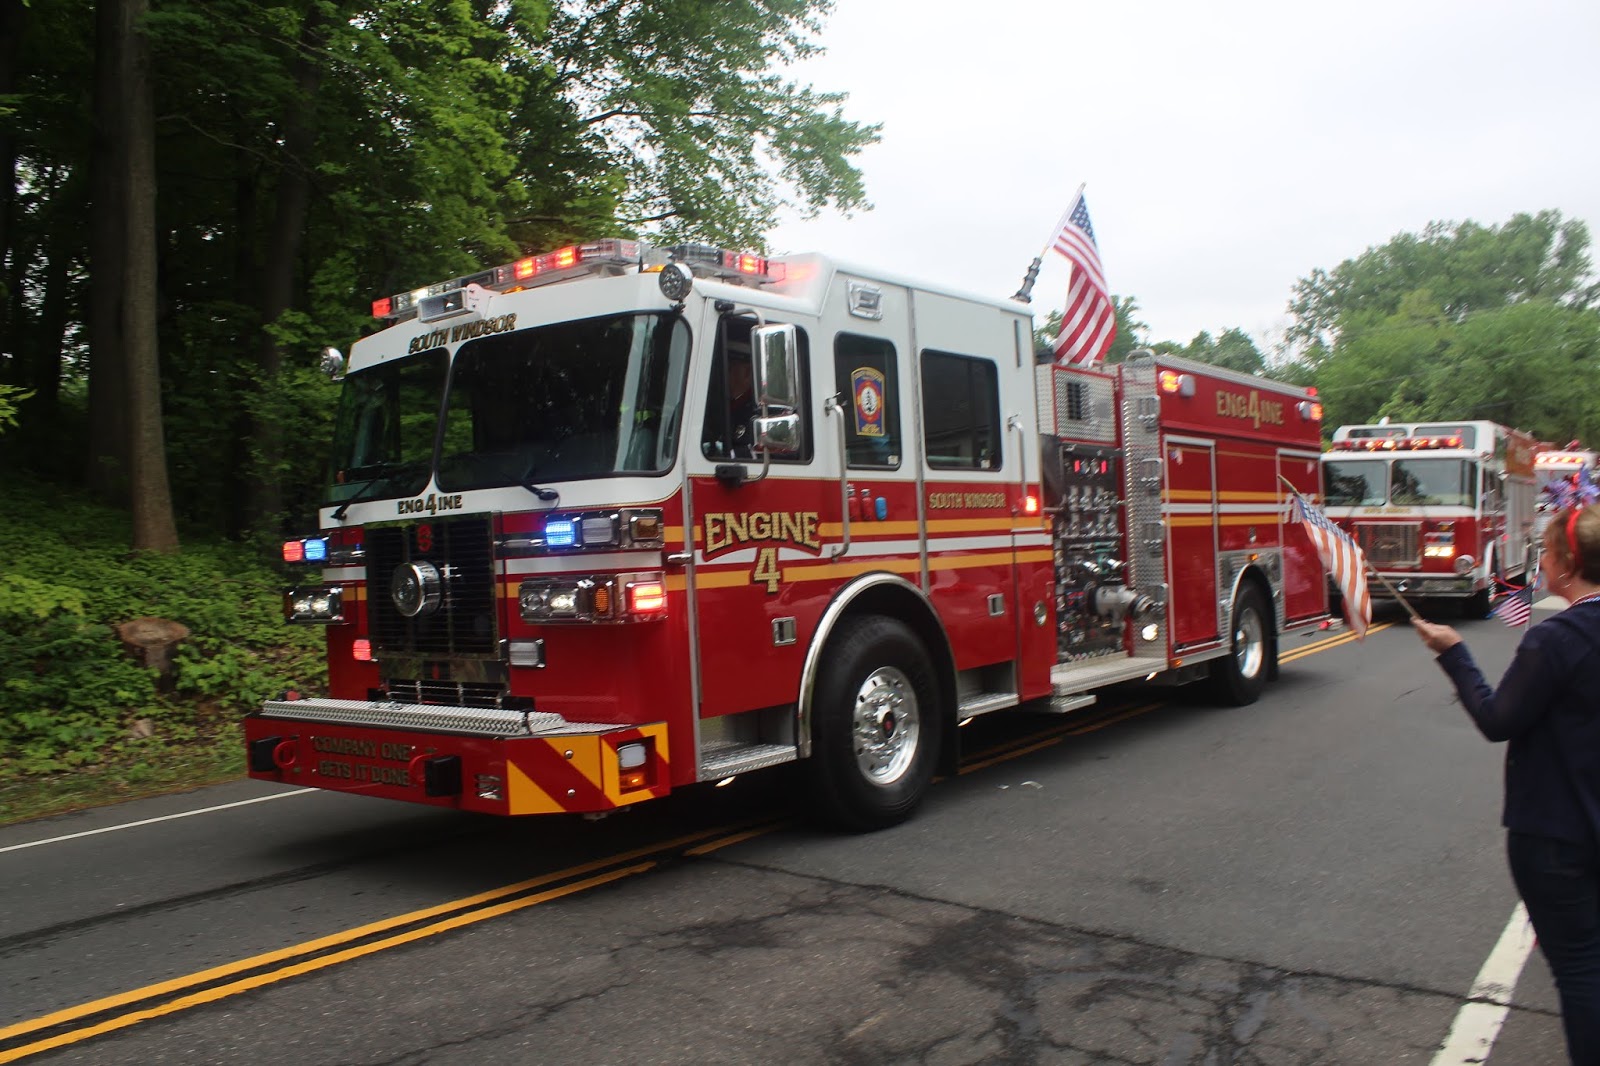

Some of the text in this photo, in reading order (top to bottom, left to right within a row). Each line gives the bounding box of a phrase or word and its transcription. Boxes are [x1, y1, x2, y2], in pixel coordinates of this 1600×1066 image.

[408, 312, 517, 354] SOUTH WINDSOR
[929, 492, 963, 508] SOUTH
[704, 511, 821, 553] ENGINE
[753, 547, 781, 594] 4
[315, 736, 411, 762] COMPANY ONE
[320, 761, 409, 786] GETS IT DONE
